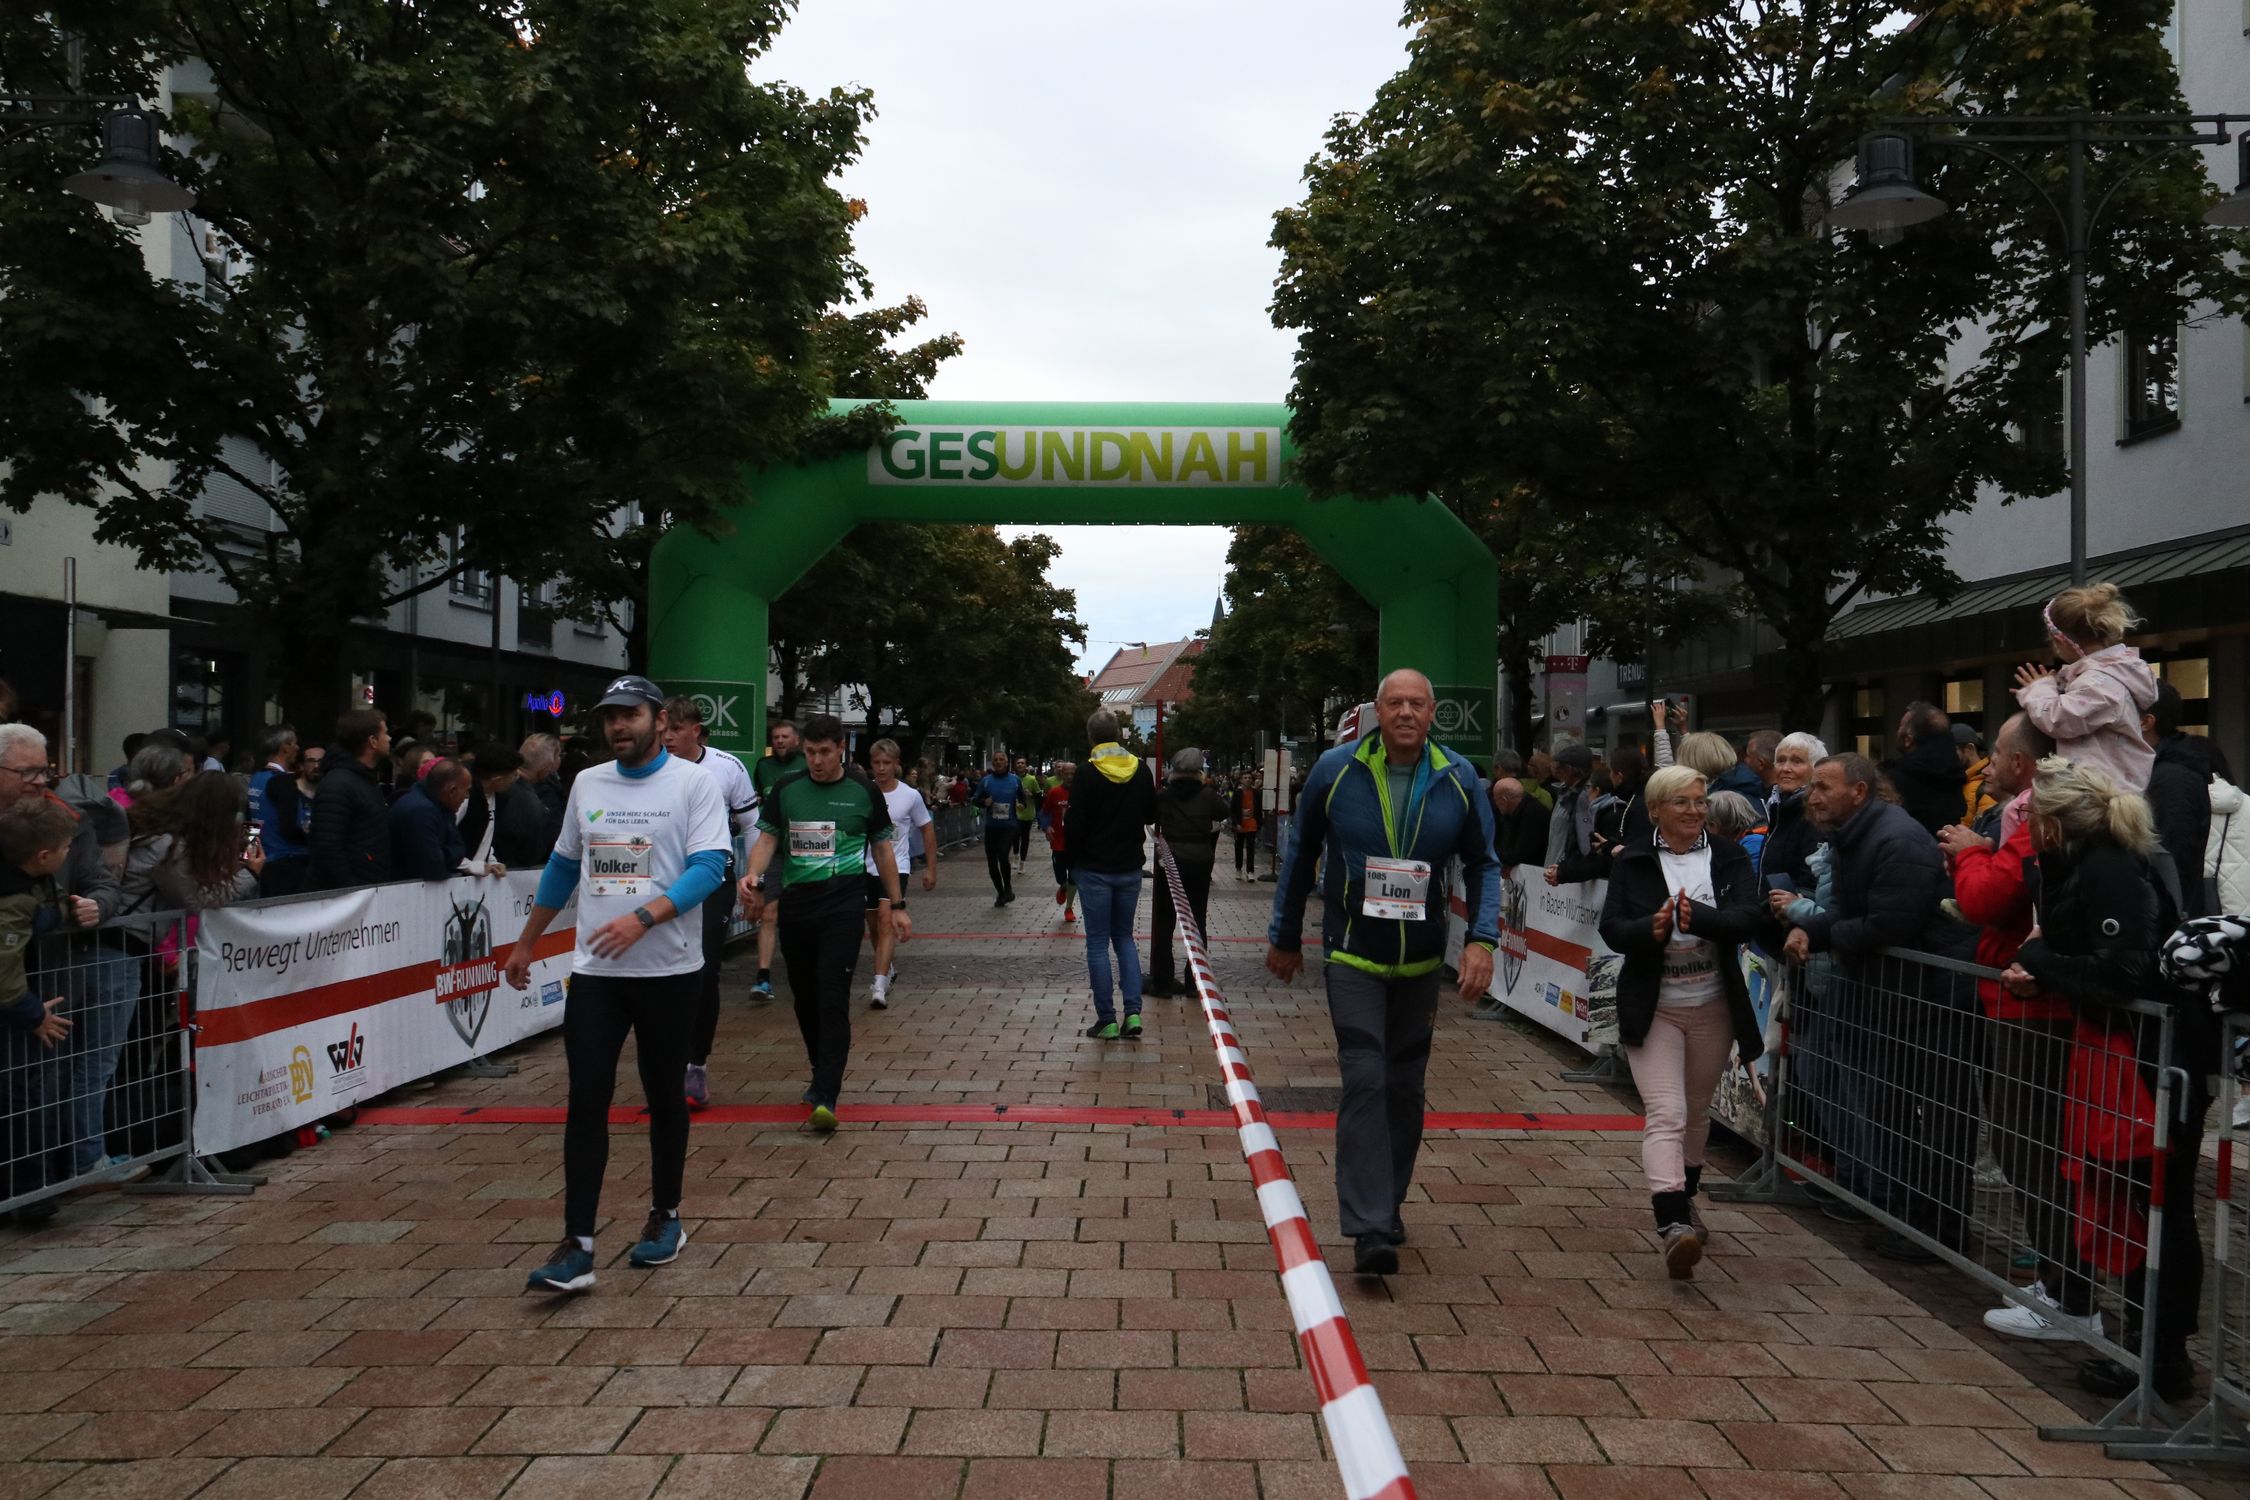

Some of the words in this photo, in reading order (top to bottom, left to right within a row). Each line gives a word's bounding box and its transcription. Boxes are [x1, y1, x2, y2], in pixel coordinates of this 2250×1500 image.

[880, 430, 1268, 481] GESUNDNAH
[792, 840, 830, 849] Michael
[594, 859, 638, 873] Volker
[1367, 871, 1387, 880] 1085
[625, 887, 637, 895] 24
[1381, 883, 1411, 898] Lion
[1402, 911, 1419, 919] 1085
[222, 939, 300, 974] Bewegt
[305, 920, 400, 961] Unternehmen
[436, 961, 498, 996] BW-RUNNING
